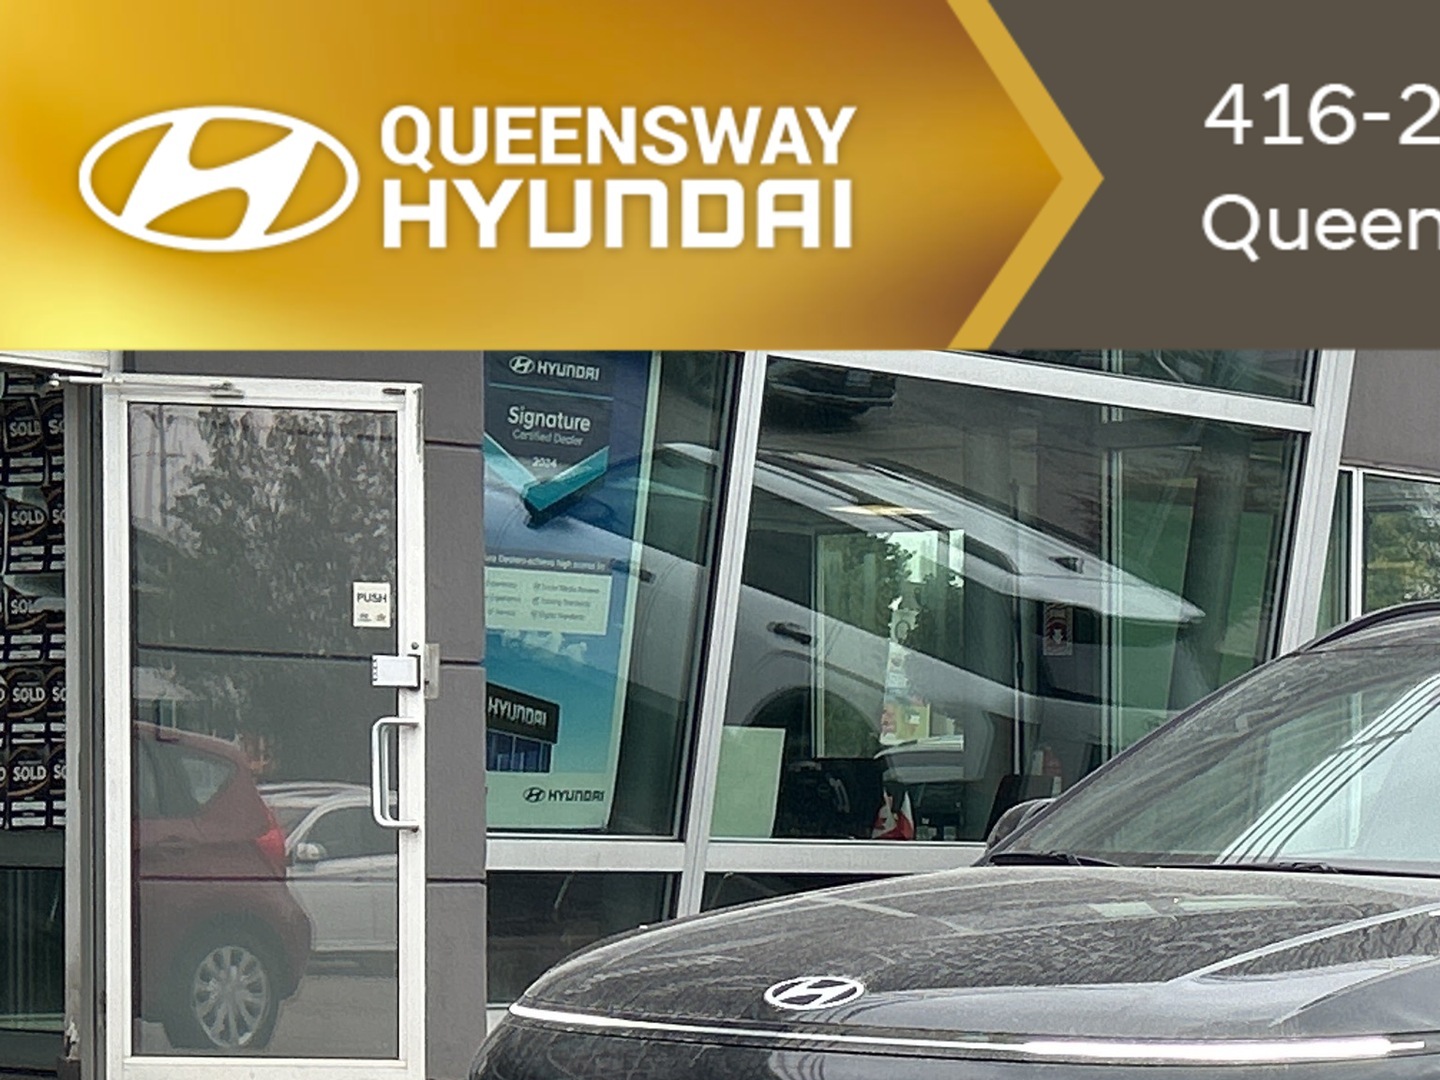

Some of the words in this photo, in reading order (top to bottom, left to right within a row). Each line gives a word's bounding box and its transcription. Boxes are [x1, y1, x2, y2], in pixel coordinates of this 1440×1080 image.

[537, 361, 600, 381] HYUNDAI
[508, 406, 591, 432] Signature
[11, 508, 45, 526] SOLD
[357, 592, 387, 603] PUSH
[12, 687, 46, 703] SOLD
[487, 696, 547, 726] HYUNDAI
[12, 765, 47, 782] SOLD
[548, 789, 605, 802] HYUNDAI
